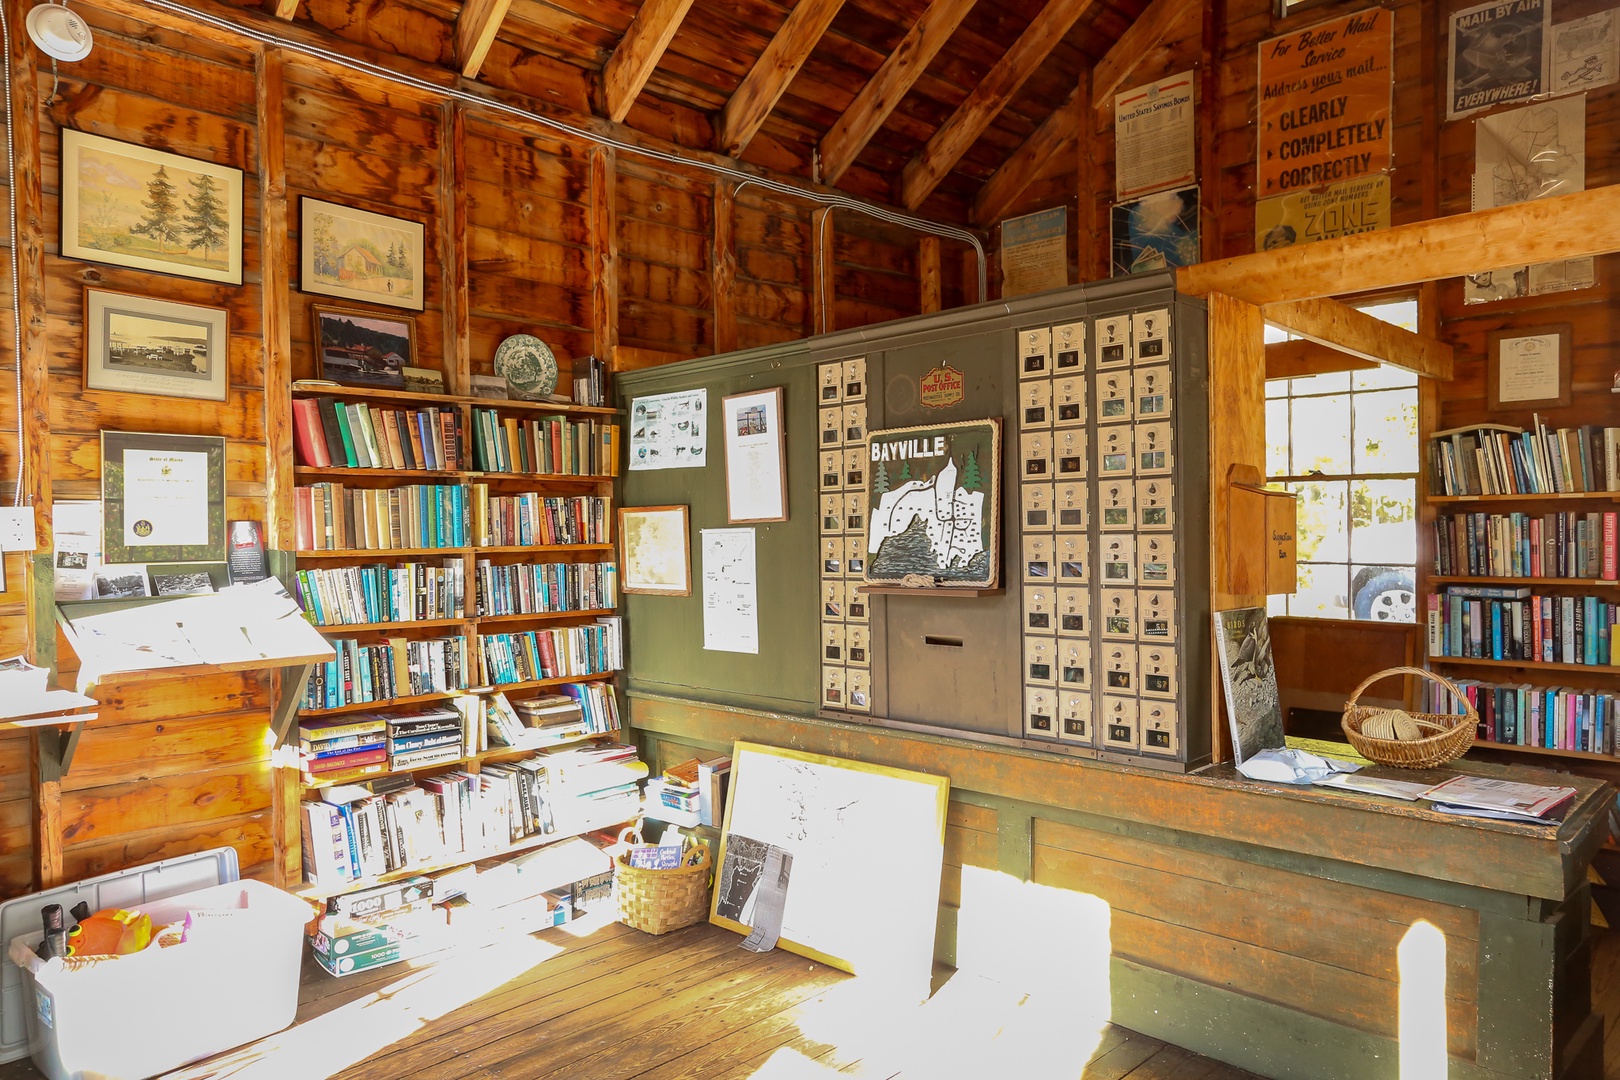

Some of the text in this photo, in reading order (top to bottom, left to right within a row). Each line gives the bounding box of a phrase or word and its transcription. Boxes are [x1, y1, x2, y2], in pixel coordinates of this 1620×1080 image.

[1459, 0, 1541, 29] MAIL BY AIR
[1271, 12, 1379, 59] For Better Mail
[1301, 47, 1346, 69] Service
[1263, 80, 1308, 101] Address
[1311, 71, 1343, 90] your
[1118, 113, 1136, 122] UNITED
[1135, 107, 1152, 117] STATES
[1280, 96, 1348, 132] CLEARLY
[1280, 118, 1386, 161] COMPLETELY
[1280, 152, 1372, 190] CORRECTLY
[1303, 200, 1322, 210] USING
[1339, 190, 1369, 202] NUMBERS
[1334, 187, 1349, 196] MAIL
[1349, 182, 1374, 194] SERVICE
[1304, 201, 1378, 237] ZONE
[923, 381, 961, 393] POST OFFICE
[871, 436, 945, 462] BAYVILLE
[1227, 620, 1245, 630] BIRDS
[351, 896, 382, 913] 1000
[371, 951, 386, 960] 1000
